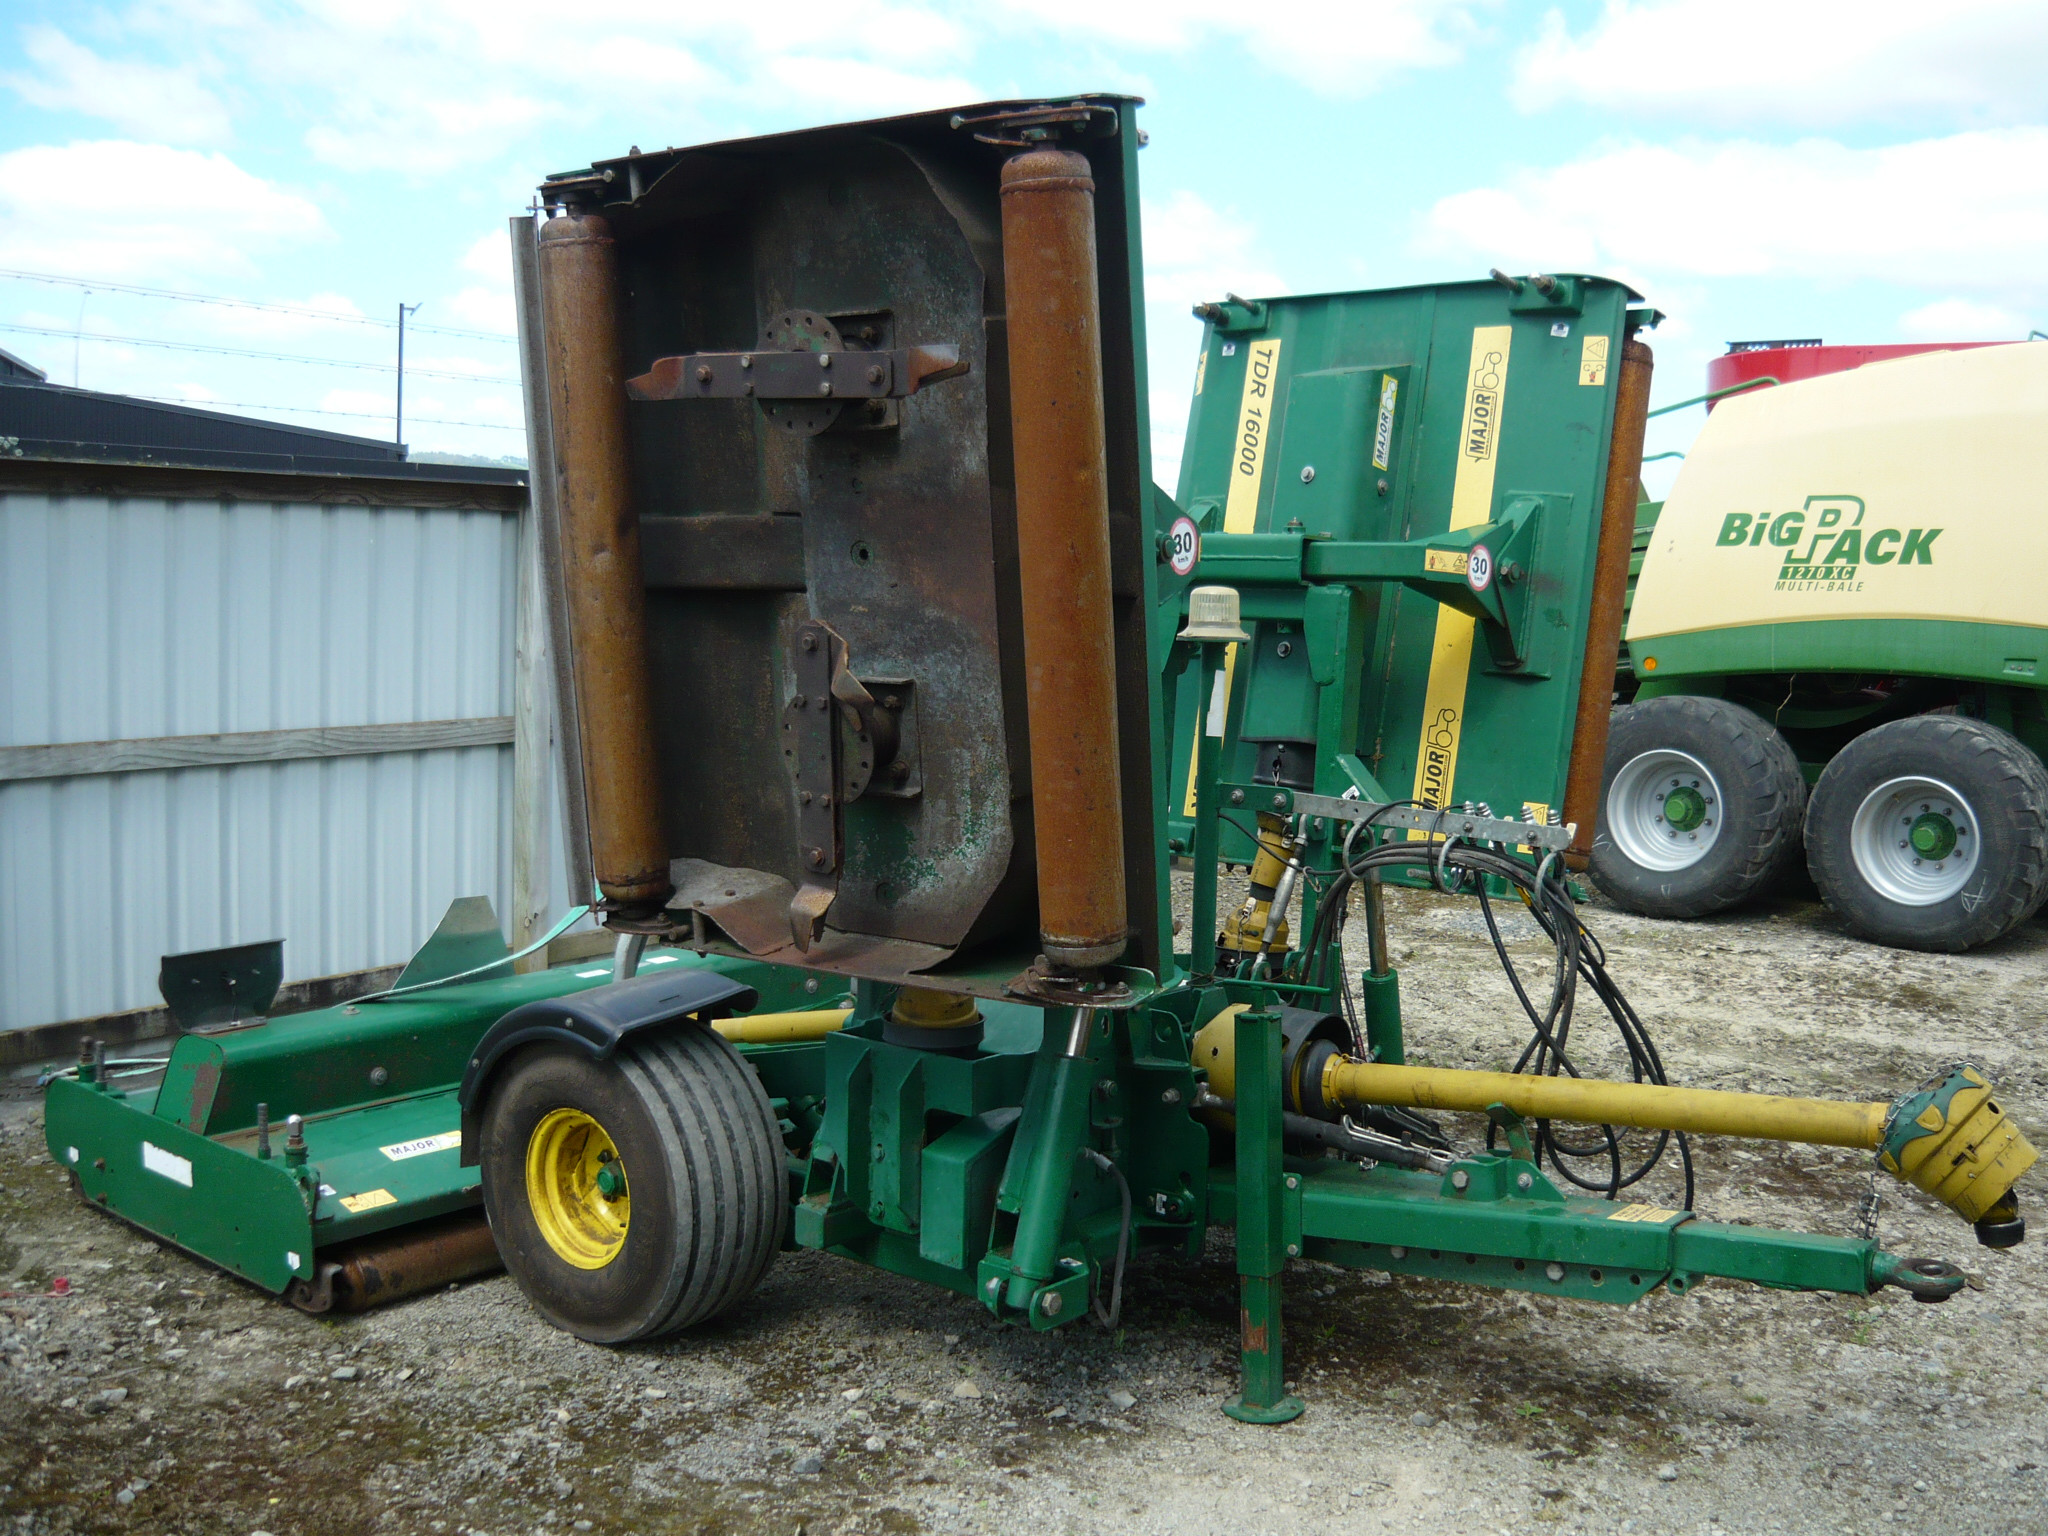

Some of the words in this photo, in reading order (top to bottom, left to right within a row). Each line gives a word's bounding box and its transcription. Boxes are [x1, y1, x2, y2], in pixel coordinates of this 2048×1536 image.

[1250, 349, 1273, 399] TDR
[1239, 408, 1263, 477] 16000
[1375, 411, 1390, 463] MAJOR
[1469, 393, 1492, 455] MAJOR
[1173, 531, 1193, 556] 30
[1783, 494, 1945, 566] PACK
[1472, 556, 1488, 576] 30
[1786, 566, 1826, 580] 1270
[1829, 566, 1852, 580] XC
[1774, 580, 1865, 592] MULTI-BALE
[390, 1139, 436, 1156] MAJOR
